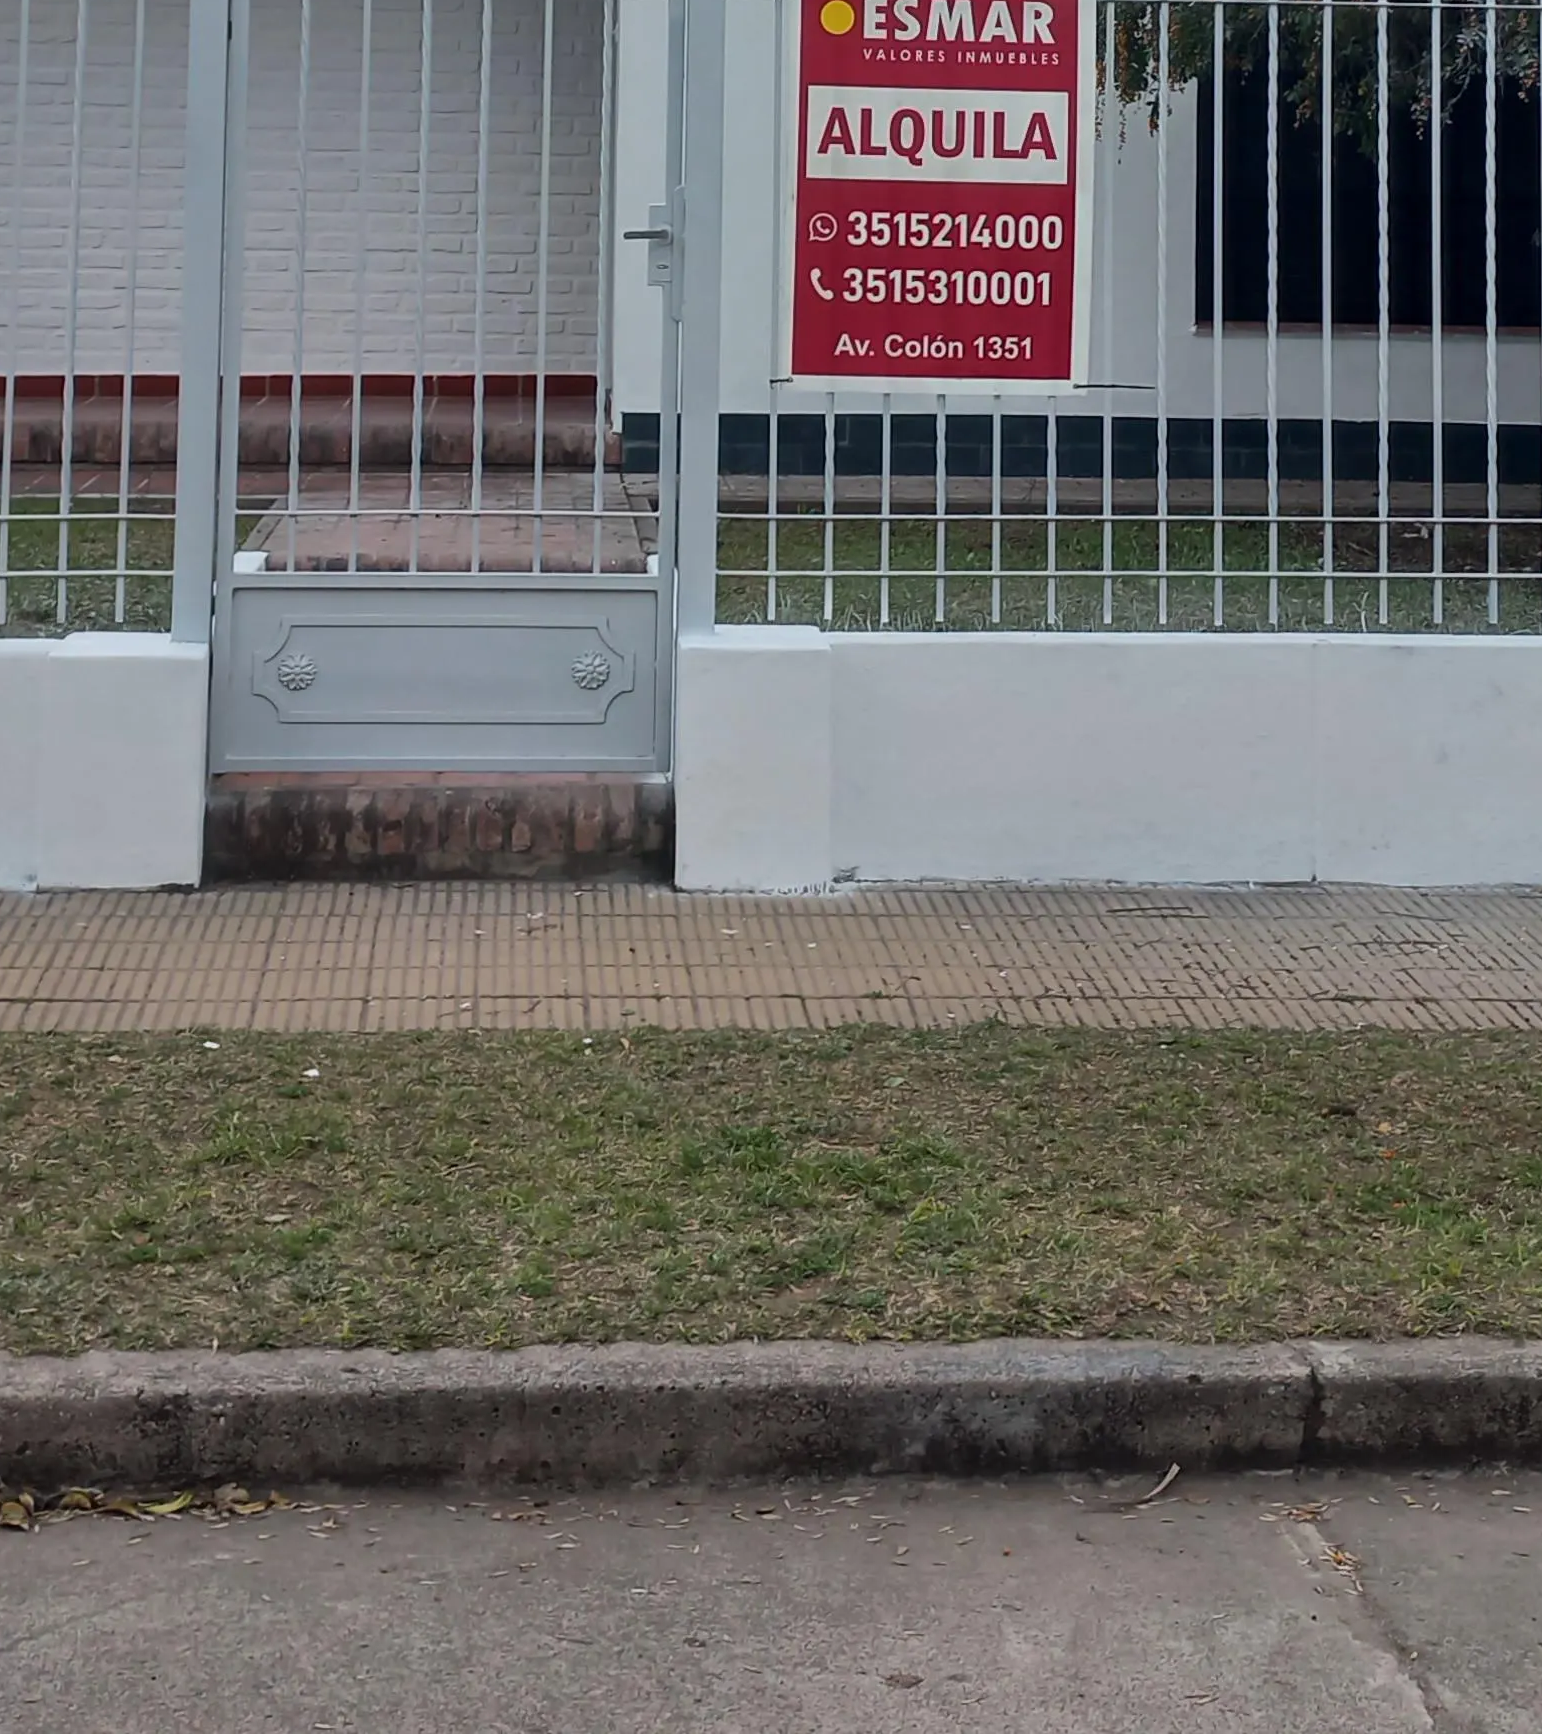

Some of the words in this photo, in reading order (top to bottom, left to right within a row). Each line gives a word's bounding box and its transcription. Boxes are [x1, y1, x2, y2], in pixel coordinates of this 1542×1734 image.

[862, 48, 946, 63] VALORES
[957, 51, 1060, 66] INMUEBLES
[816, 107, 1058, 166] ALQUILA
[847, 211, 1063, 250] 3515214000
[842, 267, 1051, 306] 3515310001
[834, 333, 875, 357] Av.
[884, 334, 963, 359] Colón
[973, 336, 1033, 360] 1351
